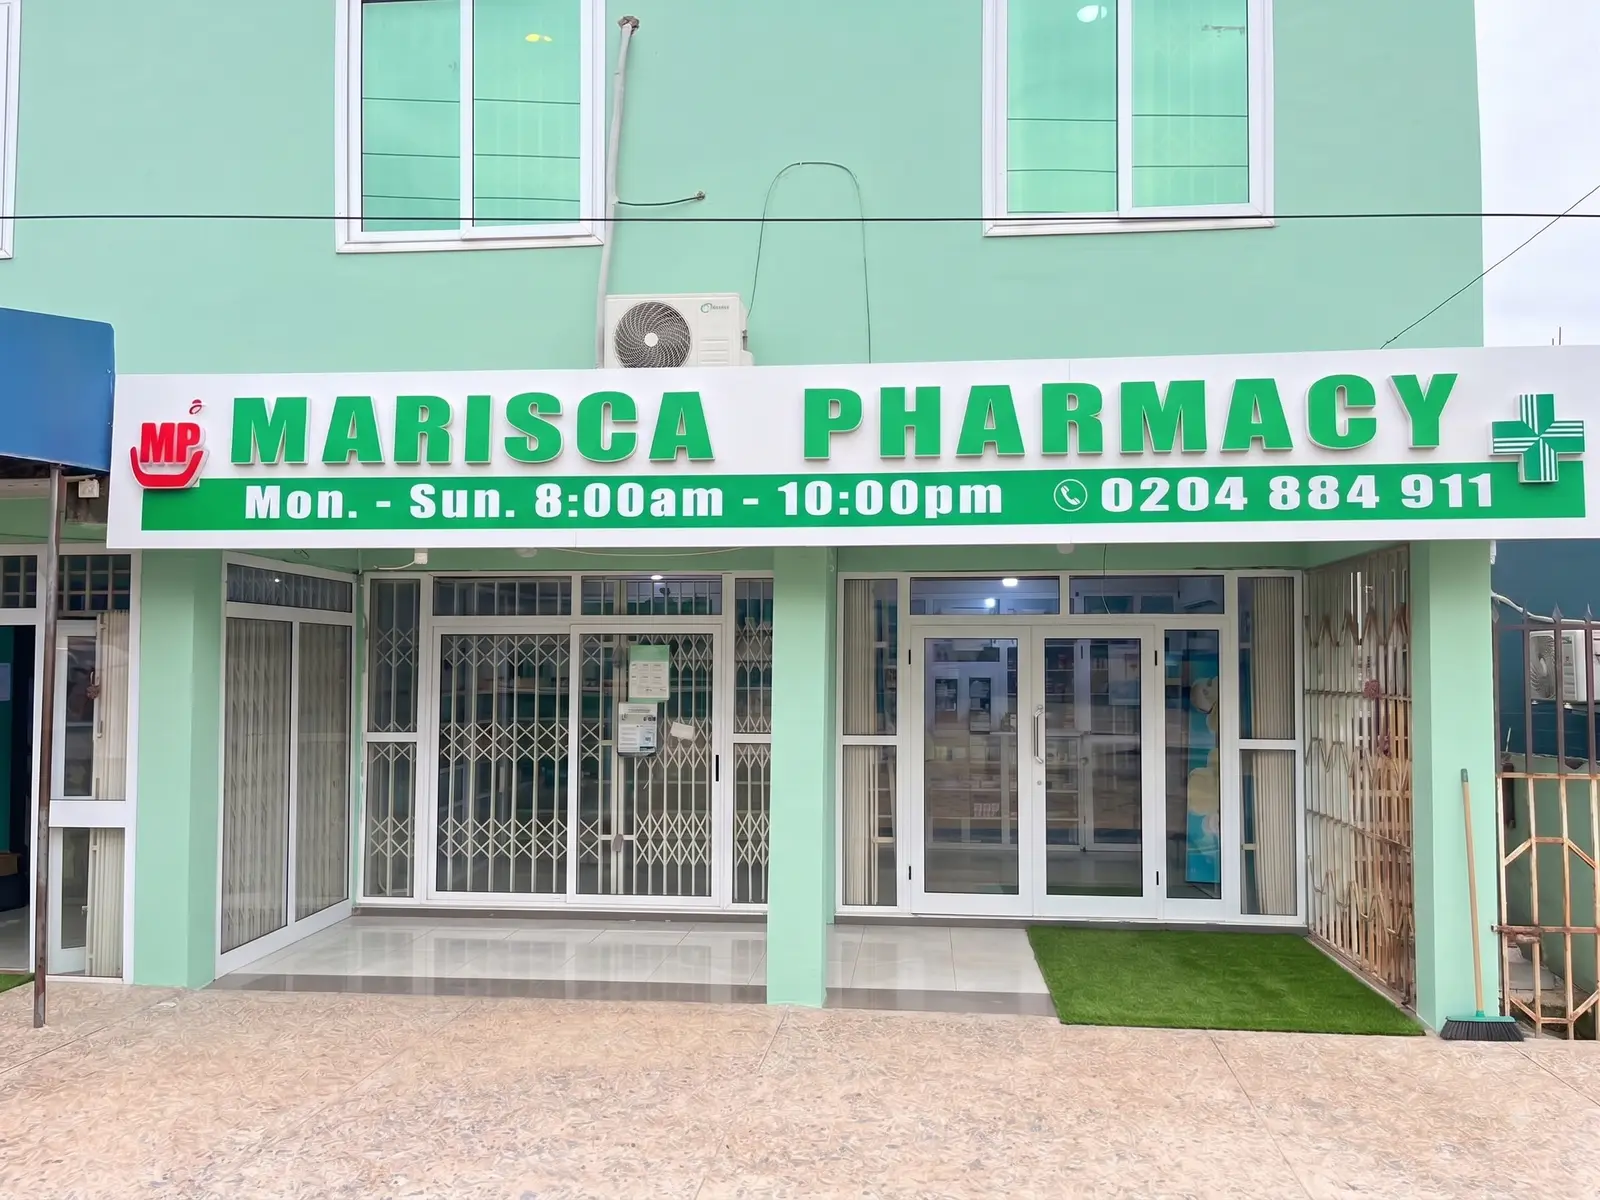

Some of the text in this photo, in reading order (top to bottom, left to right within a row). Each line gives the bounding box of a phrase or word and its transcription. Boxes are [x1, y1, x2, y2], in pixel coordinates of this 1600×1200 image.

[230, 374, 1458, 465] MARISCA PHARMACY
[139, 422, 201, 465] MP
[244, 484, 358, 519] Mon.
[409, 483, 515, 518] Sun.
[535, 483, 723, 518] 8:00am
[778, 480, 1003, 521] 10:00pm
[1101, 474, 1493, 512] 0204 884 911
